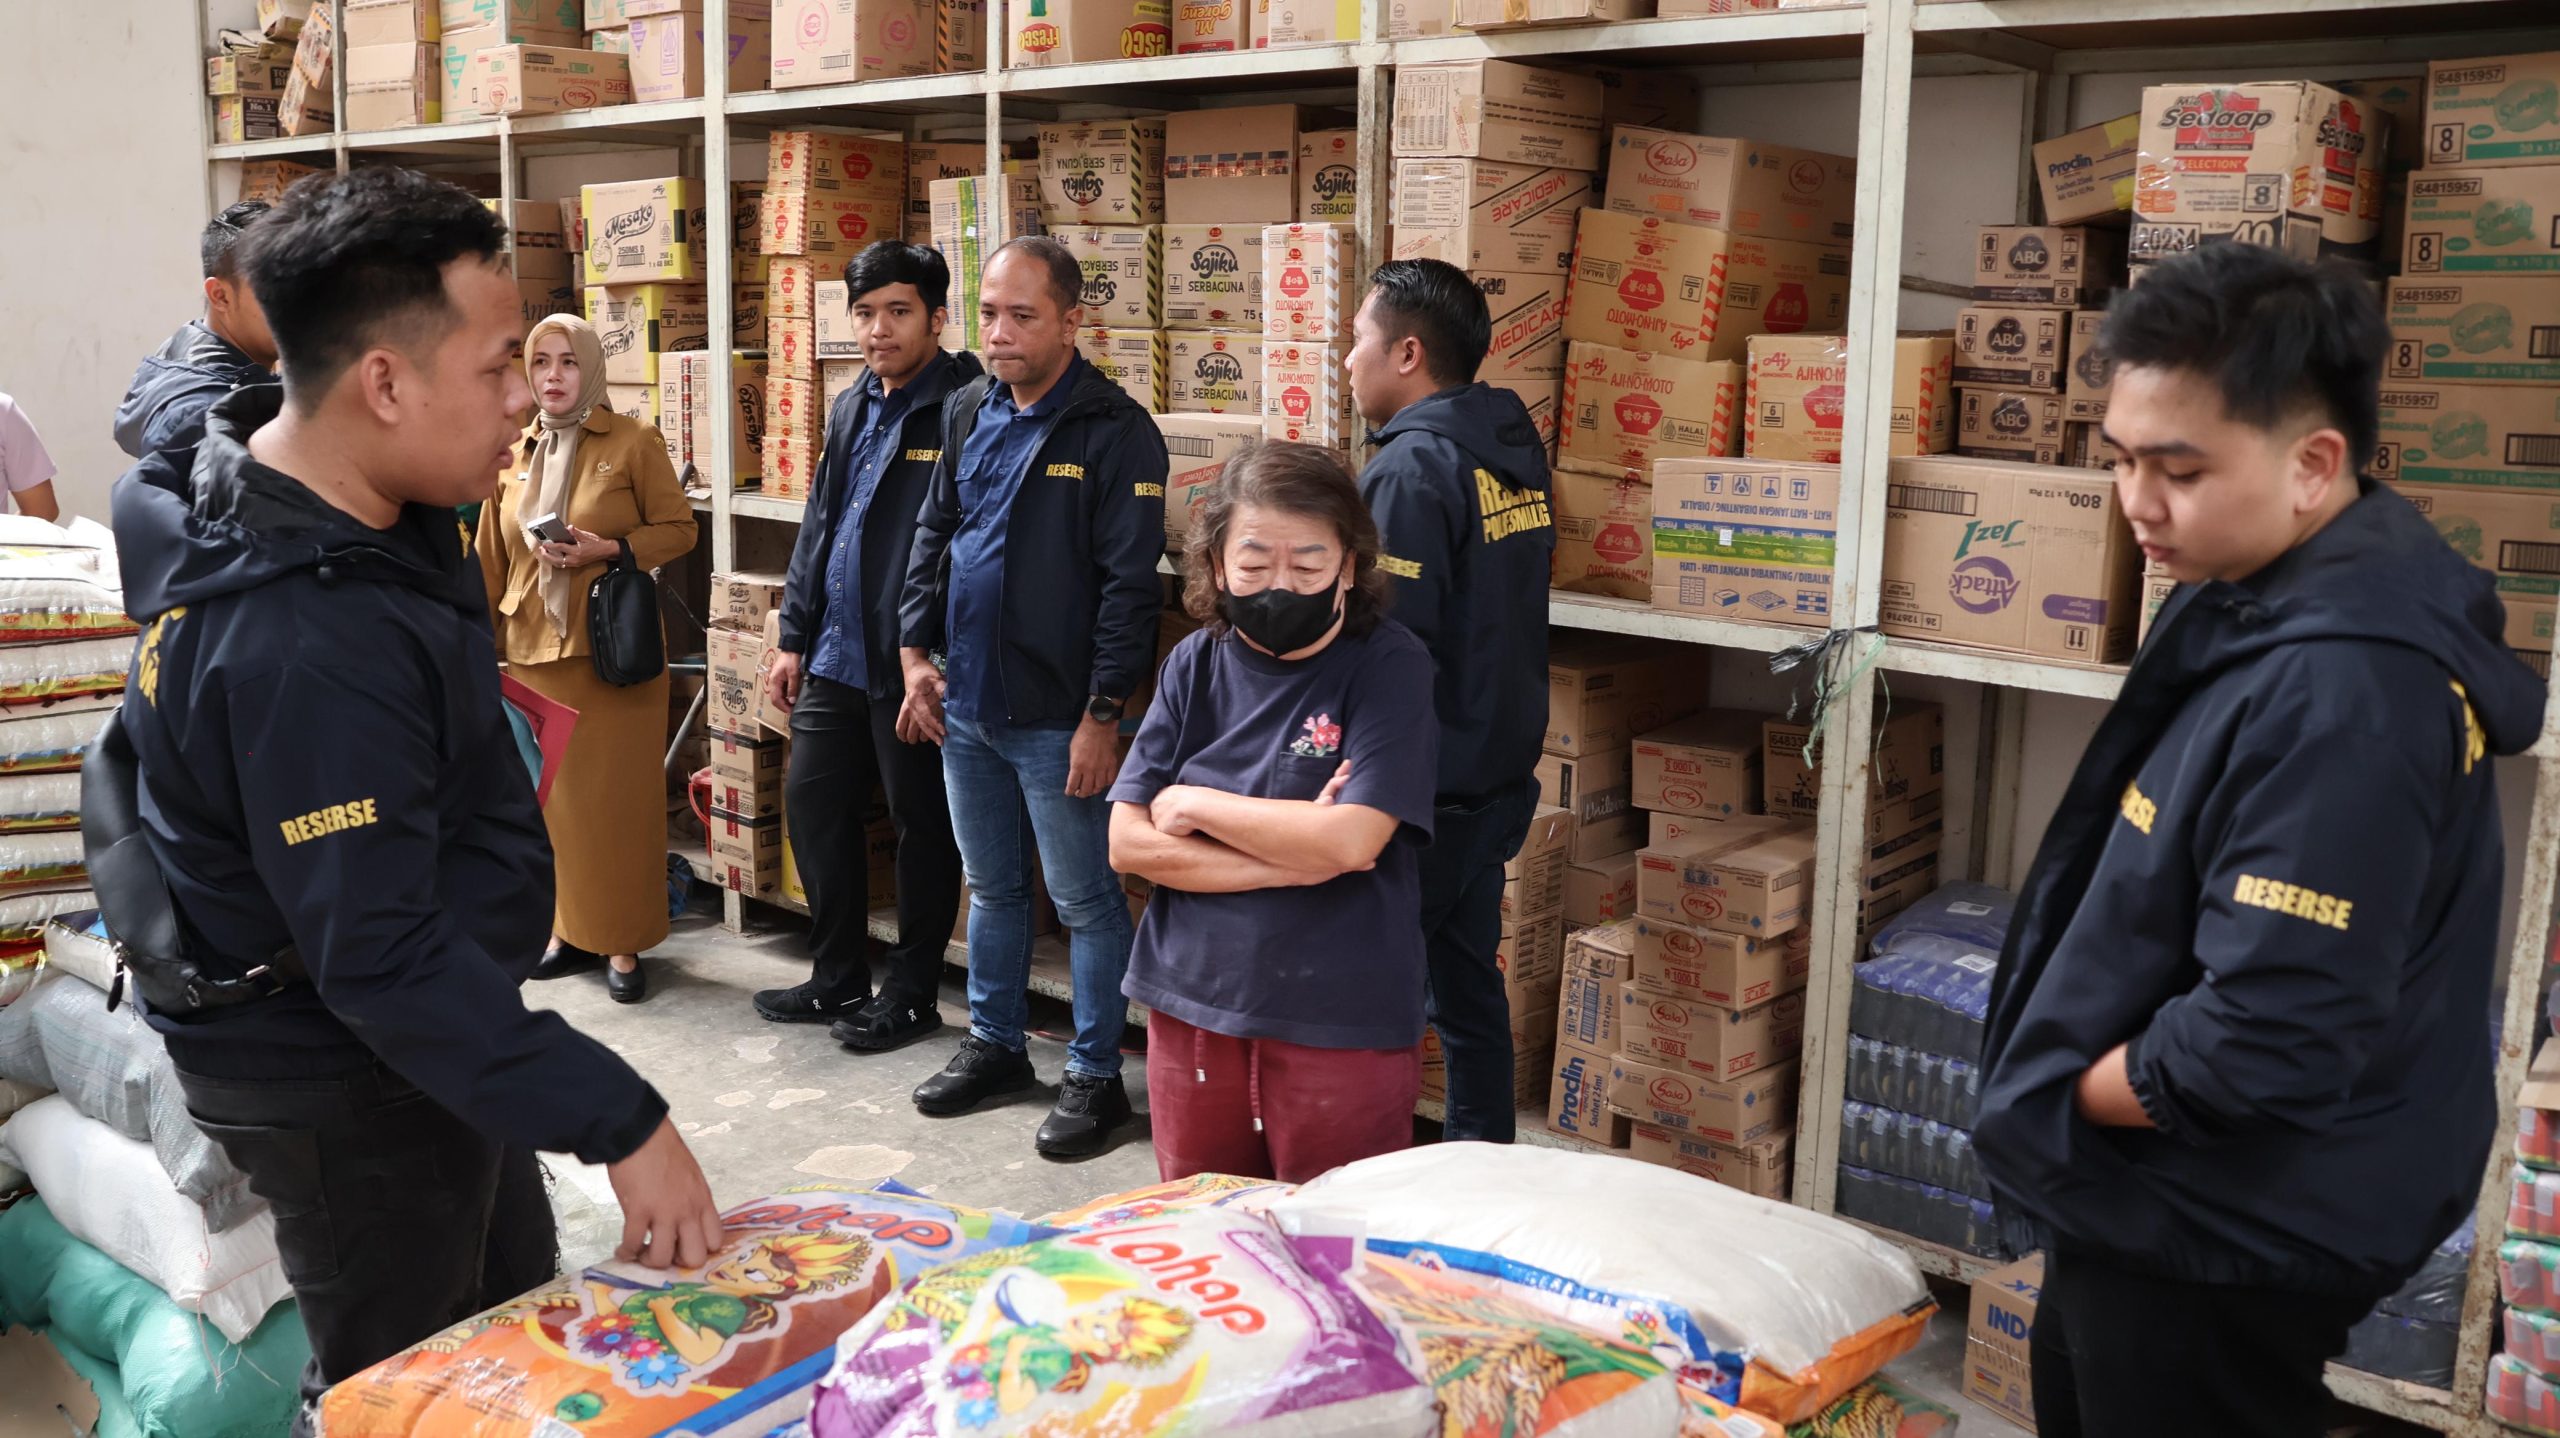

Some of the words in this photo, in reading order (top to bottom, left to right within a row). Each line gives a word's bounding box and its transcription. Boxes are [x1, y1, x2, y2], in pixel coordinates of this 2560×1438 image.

[1180, 0, 1232, 20] Goreng
[1194, 18, 1216, 36] Mi
[1018, 26, 1060, 50] Fresco
[2438, 68, 2501, 84] 64815957
[2160, 108, 2274, 132] Sedaap
[2439, 127, 2453, 152] 8
[1062, 170, 1104, 197] Sajiku
[2415, 181, 2478, 194] 64815957
[1491, 173, 1568, 223] MEDICARE
[2255, 186, 2270, 205] 8
[1311, 203, 1356, 215] SERBAGU
[605, 204, 653, 239] Masako
[2013, 249, 2046, 265] ABC
[2418, 237, 2432, 262] 8
[1082, 261, 1118, 272] SERBAGU
[1190, 249, 1239, 279] Sajiku
[1583, 268, 1604, 278] HALAL
[1188, 281, 1245, 293] SERBAGUNA
[2061, 287, 2069, 299] 8
[2395, 289, 2458, 302] 64815957
[1243, 309, 1256, 320] 75
[1606, 308, 1667, 330] AJI-NO-MOTO
[1991, 333, 2024, 348] ABC
[2399, 343, 2411, 368] 8
[1194, 357, 1243, 387] Sajiku
[1277, 372, 1315, 385] AJI-NO-MOTO
[1796, 366, 1846, 382] AJI-NO-M
[2037, 370, 2045, 381] 8
[1611, 372, 1675, 394] AJI-NO-MOTO
[1192, 388, 1248, 402] SERBAGUNA
[2382, 395, 2435, 406] 4815957
[1770, 405, 1776, 416] 6
[1995, 413, 2027, 428] ABC
[1678, 425, 1705, 436] HALAL
[1046, 463, 1085, 481] RESERS
[1134, 482, 1164, 498] RESE
[1680, 500, 1711, 511] DIBALIK
[1716, 502, 1758, 515] DIBANTING
[1759, 506, 1789, 518] JANGAN
[1790, 509, 1808, 519] HATI
[1814, 511, 1832, 520] HATI
[1680, 562, 1696, 571] HATI
[1702, 564, 1719, 573] HATI
[1719, 565, 1749, 576] JANGAN
[1750, 568, 1793, 581] DIBANTING
[1799, 572, 1831, 585] DIBALIK
[1951, 573, 2021, 609] Attack
[1792, 792, 1818, 807] Rins
[280, 797, 378, 846] RESERSE
[2234, 873, 2353, 930] RESERSE
[1557, 1056, 1586, 1132] Proclin
[1589, 1098, 1601, 1128] Sachet
[720, 1198, 954, 1247] ahap
[1986, 1303, 2033, 1341] IND
